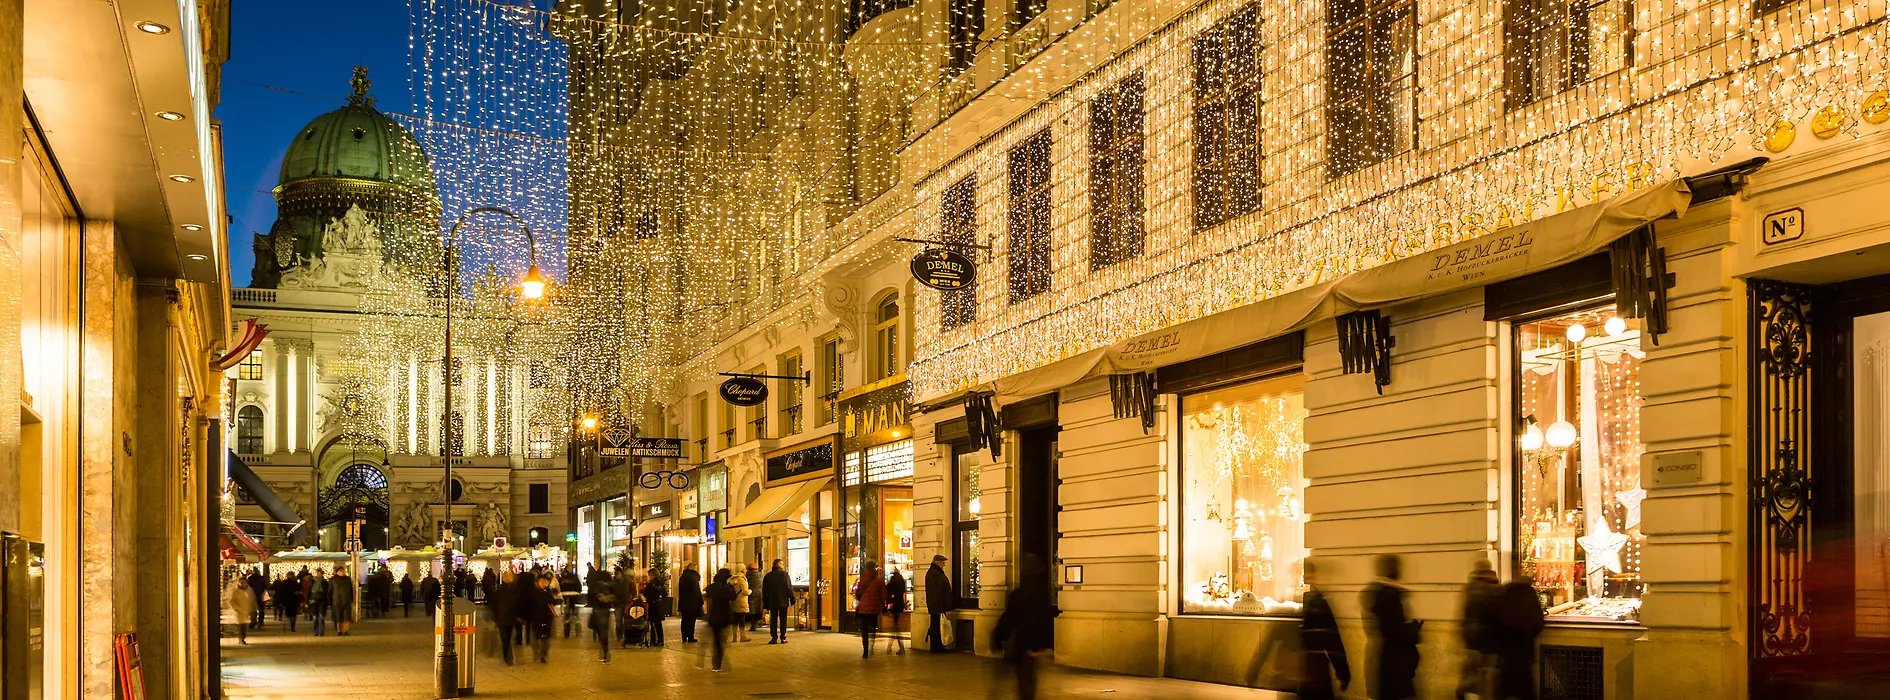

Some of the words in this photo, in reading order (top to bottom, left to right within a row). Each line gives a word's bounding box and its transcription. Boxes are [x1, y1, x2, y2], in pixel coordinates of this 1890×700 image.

[1430, 229, 1533, 272] DEMEL
[926, 260, 964, 274] DEMEL
[1120, 331, 1181, 354] DEMEL
[724, 382, 764, 397] Chopard
[863, 399, 906, 435] MAN
[600, 447, 630, 456] JUWELEN
[631, 448, 680, 457] ANTIKSCHMUCK
